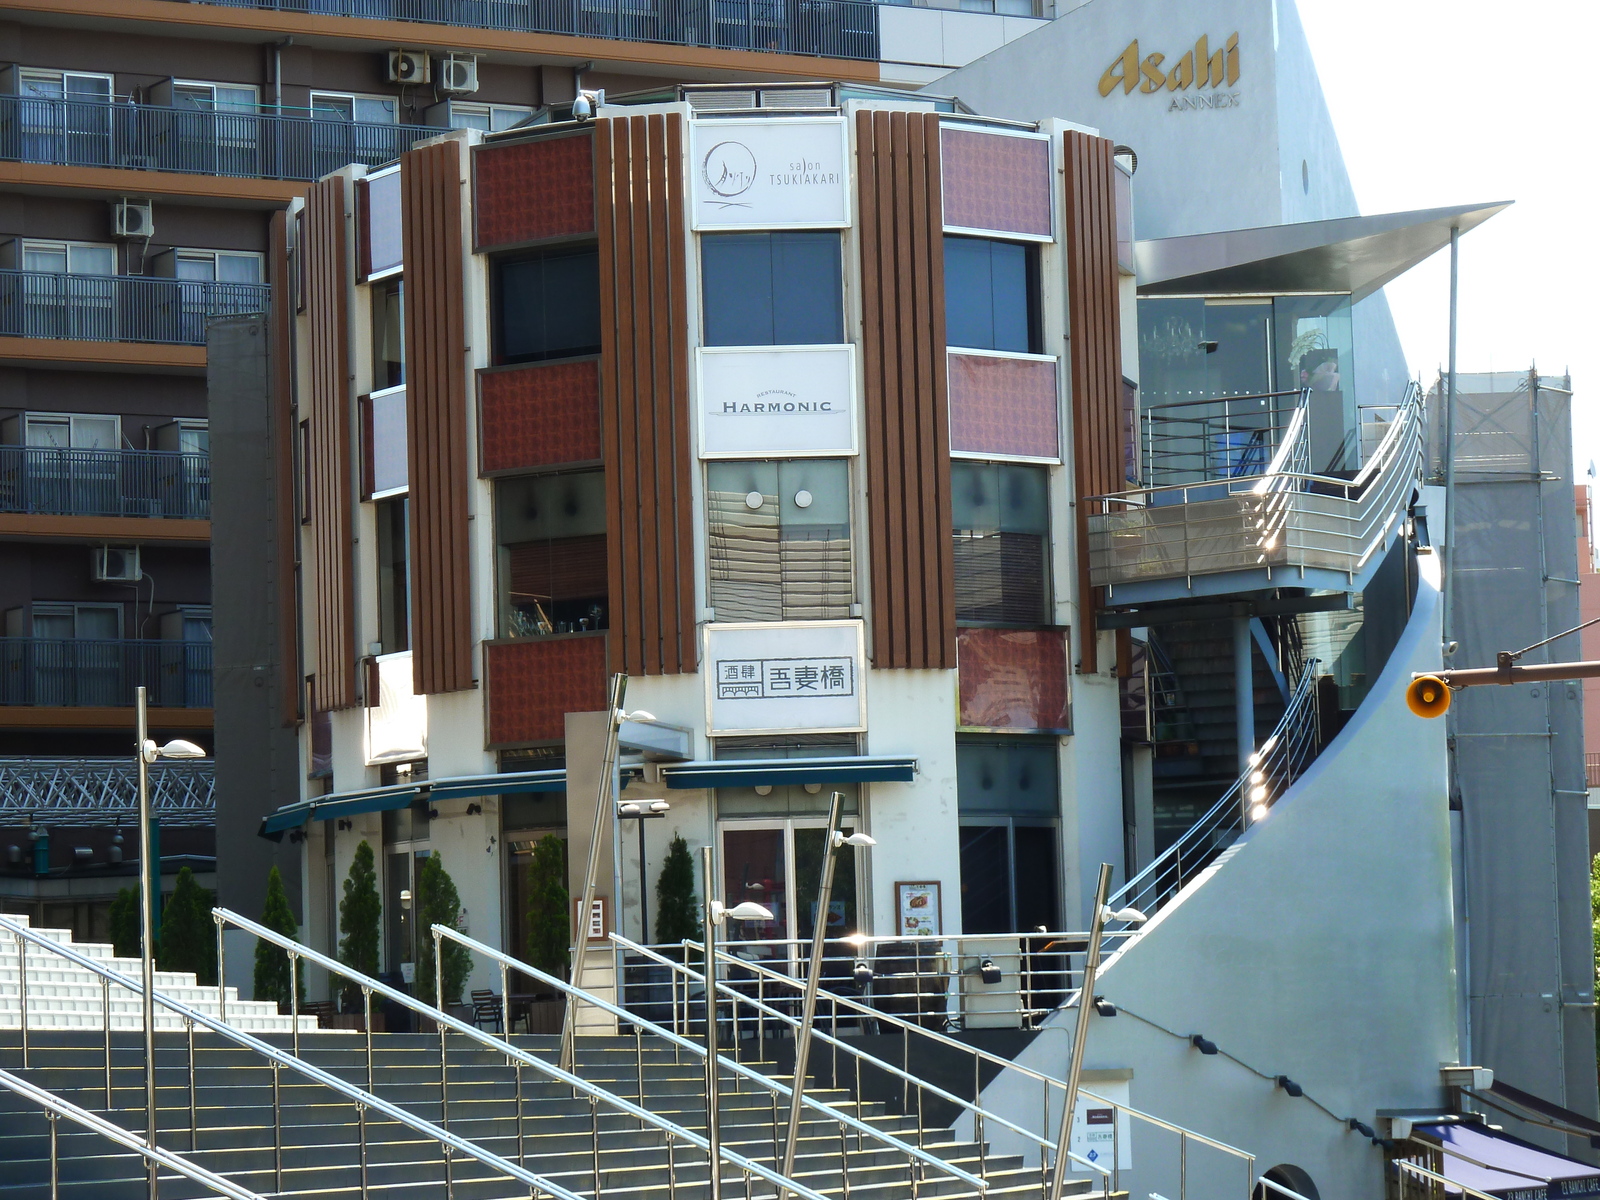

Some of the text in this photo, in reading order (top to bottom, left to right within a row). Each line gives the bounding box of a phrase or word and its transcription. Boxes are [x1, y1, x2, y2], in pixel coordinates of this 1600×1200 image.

[1098, 31, 1240, 97] Asahi
[1168, 92, 1240, 112] ANNEX
[769, 173, 840, 186] TSUKIAKARI
[756, 389, 797, 399] RESTAURANT
[722, 401, 832, 413] HARMONIC
[724, 664, 756, 680] 酒肆
[769, 665, 845, 691] 吾妻橋
[1534, 1188, 1548, 1200] CAFE
[1561, 1181, 1568, 1195] 23
[1587, 1178, 1600, 1192] CAFE
